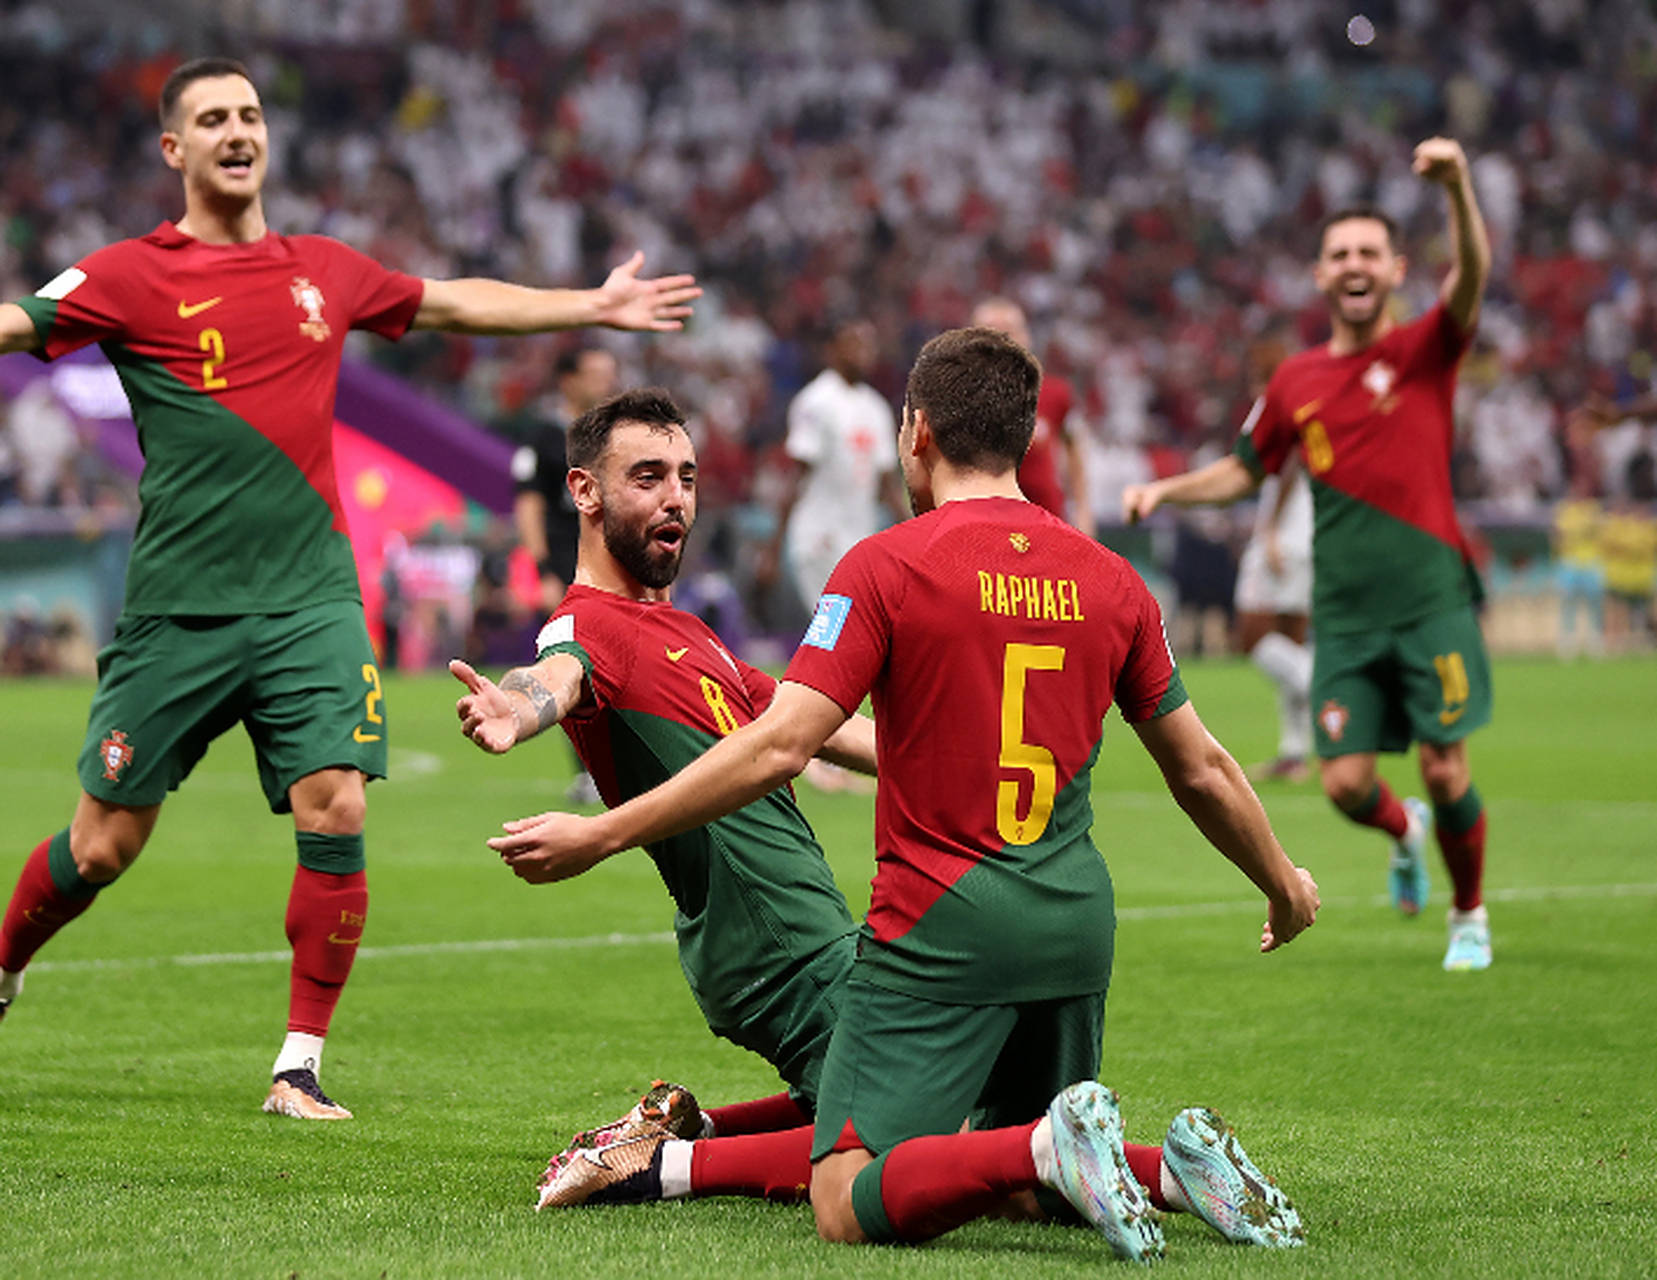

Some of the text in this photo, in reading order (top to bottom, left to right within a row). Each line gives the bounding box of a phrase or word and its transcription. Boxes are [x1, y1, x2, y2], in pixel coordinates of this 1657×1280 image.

[199, 327, 228, 390] 2
[978, 570, 1085, 621] RAPHAEL
[362, 663, 382, 724] 2
[699, 675, 740, 736] 8
[996, 642, 1066, 846] 5
